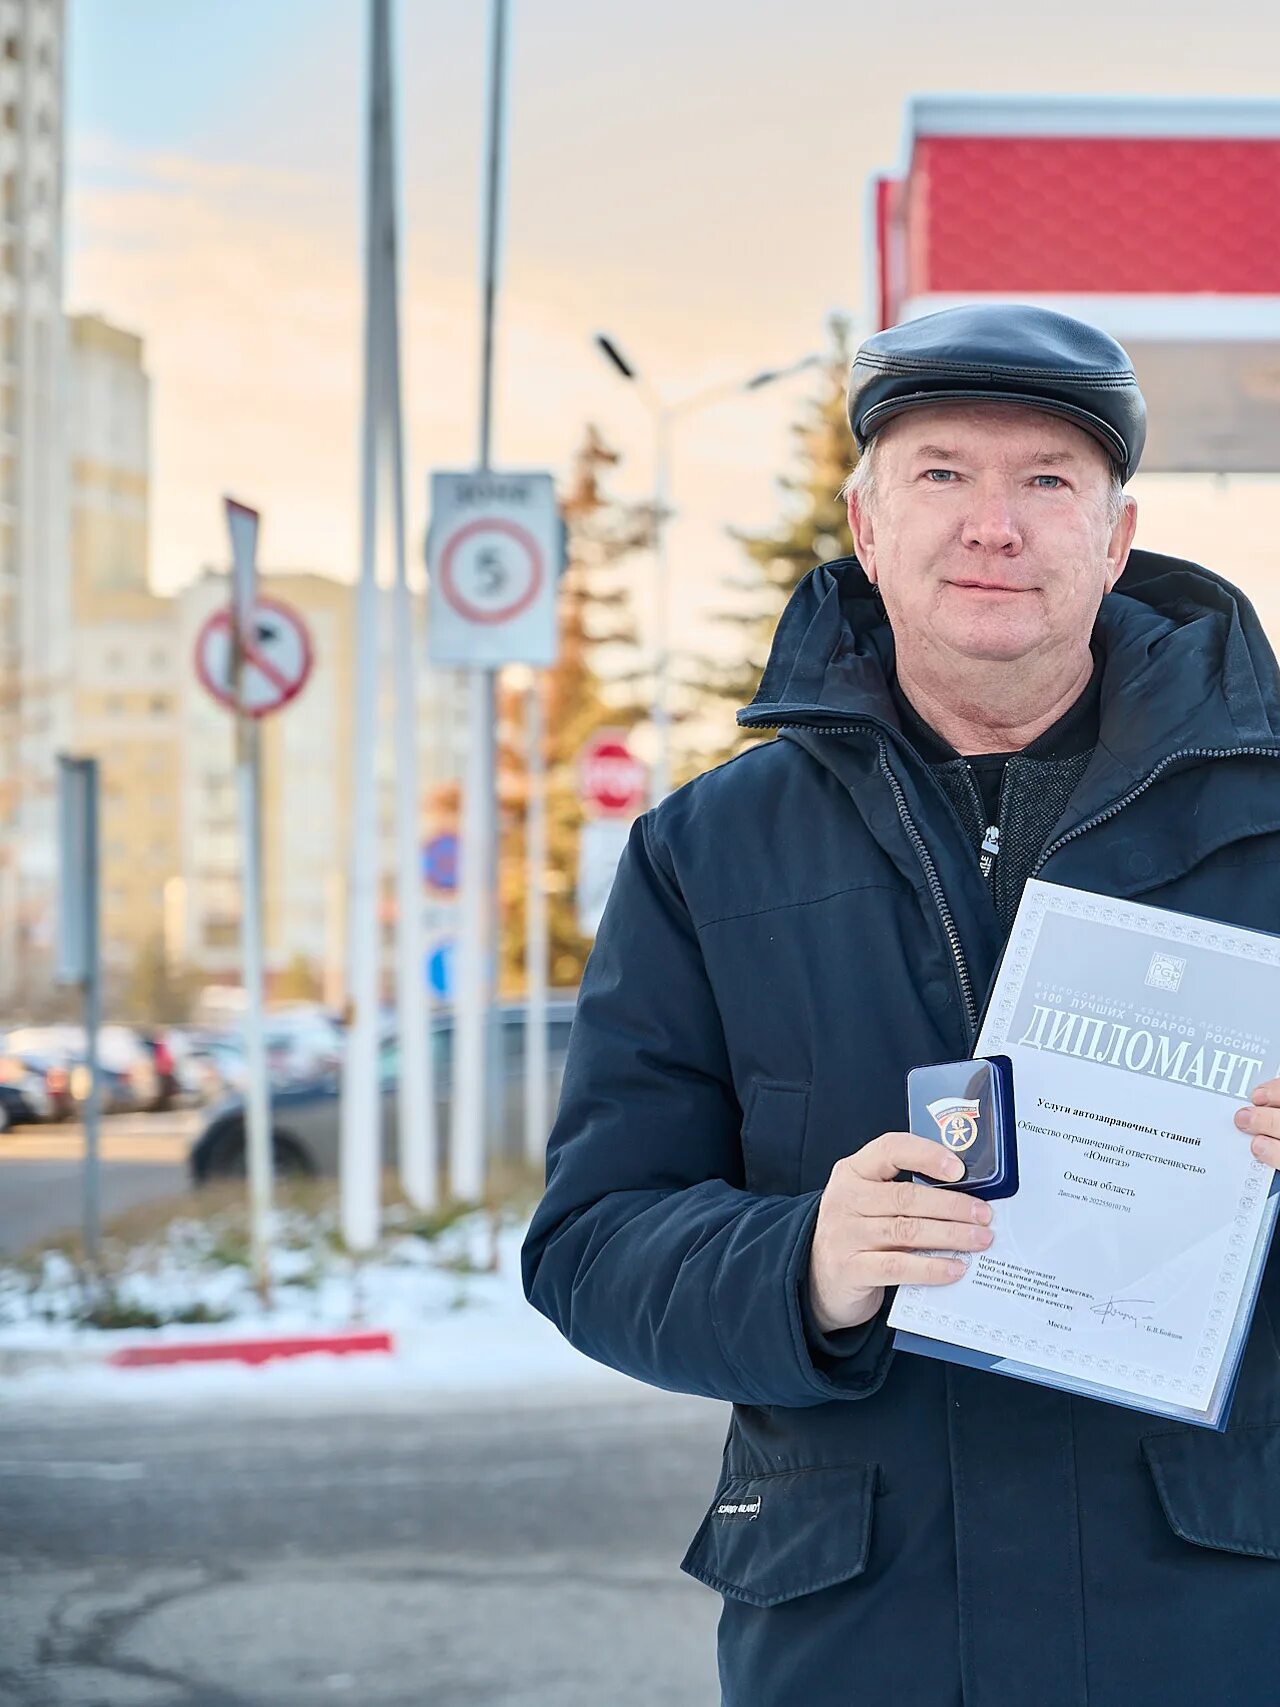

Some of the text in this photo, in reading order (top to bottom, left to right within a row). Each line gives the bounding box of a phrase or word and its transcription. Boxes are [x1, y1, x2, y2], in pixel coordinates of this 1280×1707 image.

[474, 547, 509, 597] 5
[1071, 998, 1126, 1019] ЛУЧШИХ
[1134, 1013, 1196, 1037] ТОВАРОВ
[1205, 1032, 1267, 1055] РОССИИ»
[1018, 1004, 1263, 1099] ДИПЛОМАНТ
[1017, 1119, 1206, 1175] Общество ограниченной ответственностью
[1037, 1098, 1202, 1147] Услуги автозаправочных станций
[1083, 1149, 1130, 1168] «Юнигаз»
[1063, 1171, 1136, 1197] Омская область
[1047, 1319, 1072, 1332] Москва
